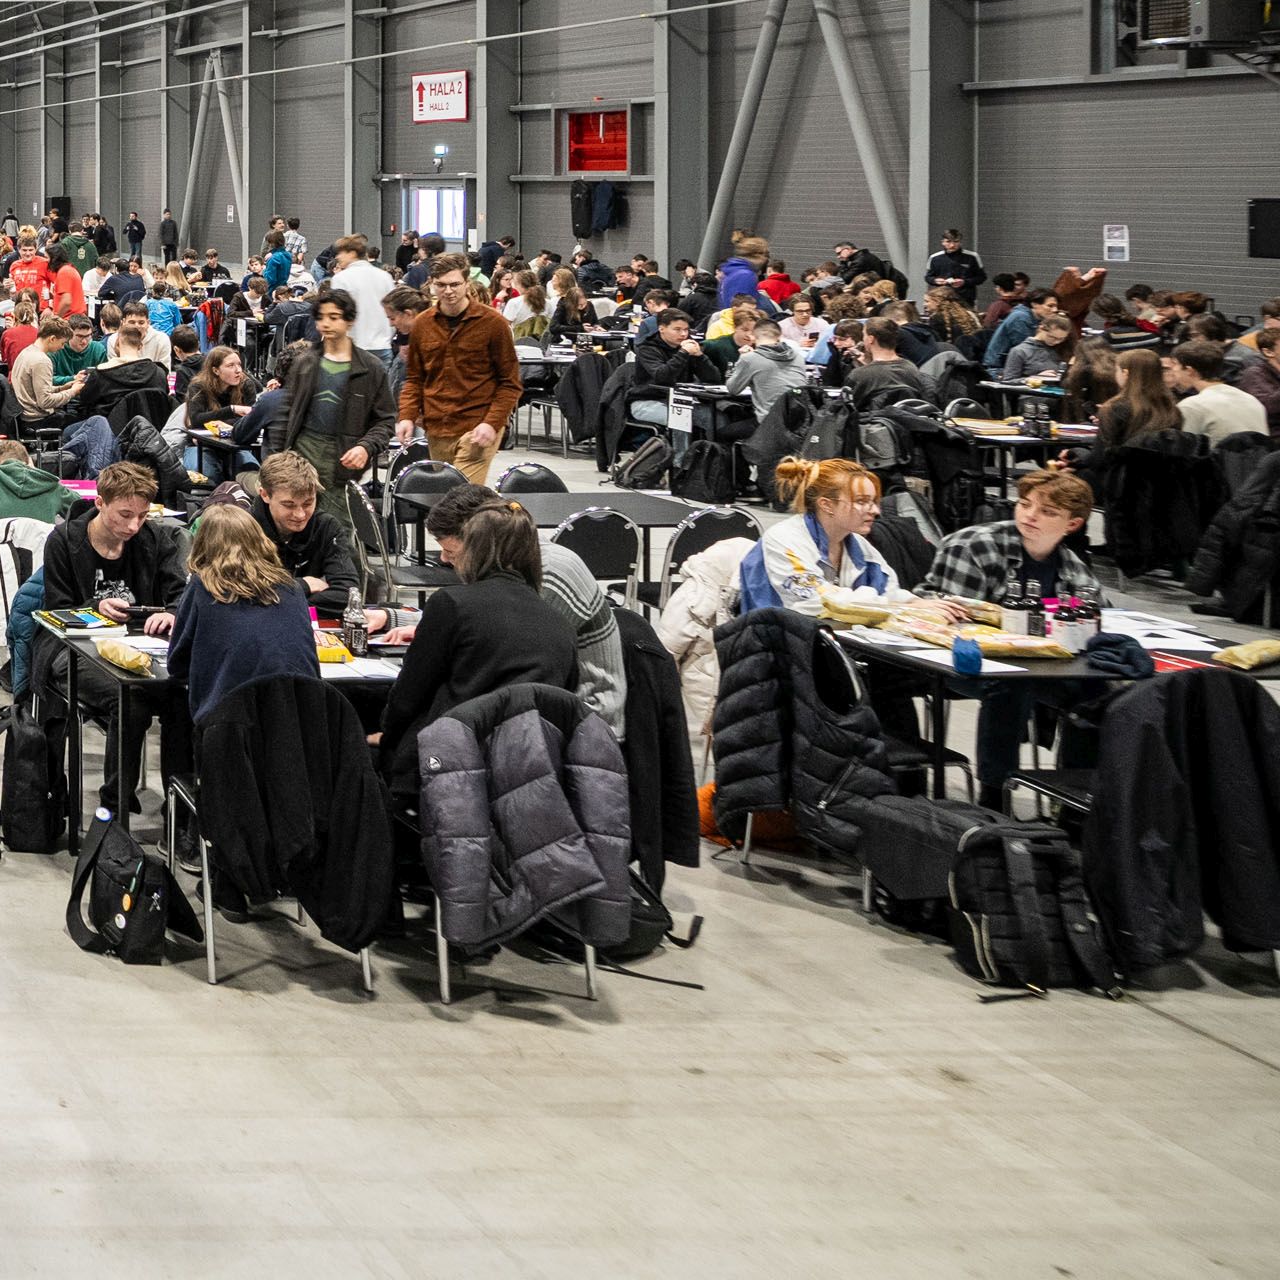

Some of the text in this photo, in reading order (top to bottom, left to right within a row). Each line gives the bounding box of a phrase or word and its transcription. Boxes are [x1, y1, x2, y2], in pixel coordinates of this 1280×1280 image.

[429, 80, 463, 97] HALA 2
[429, 102, 444, 111] HALL
